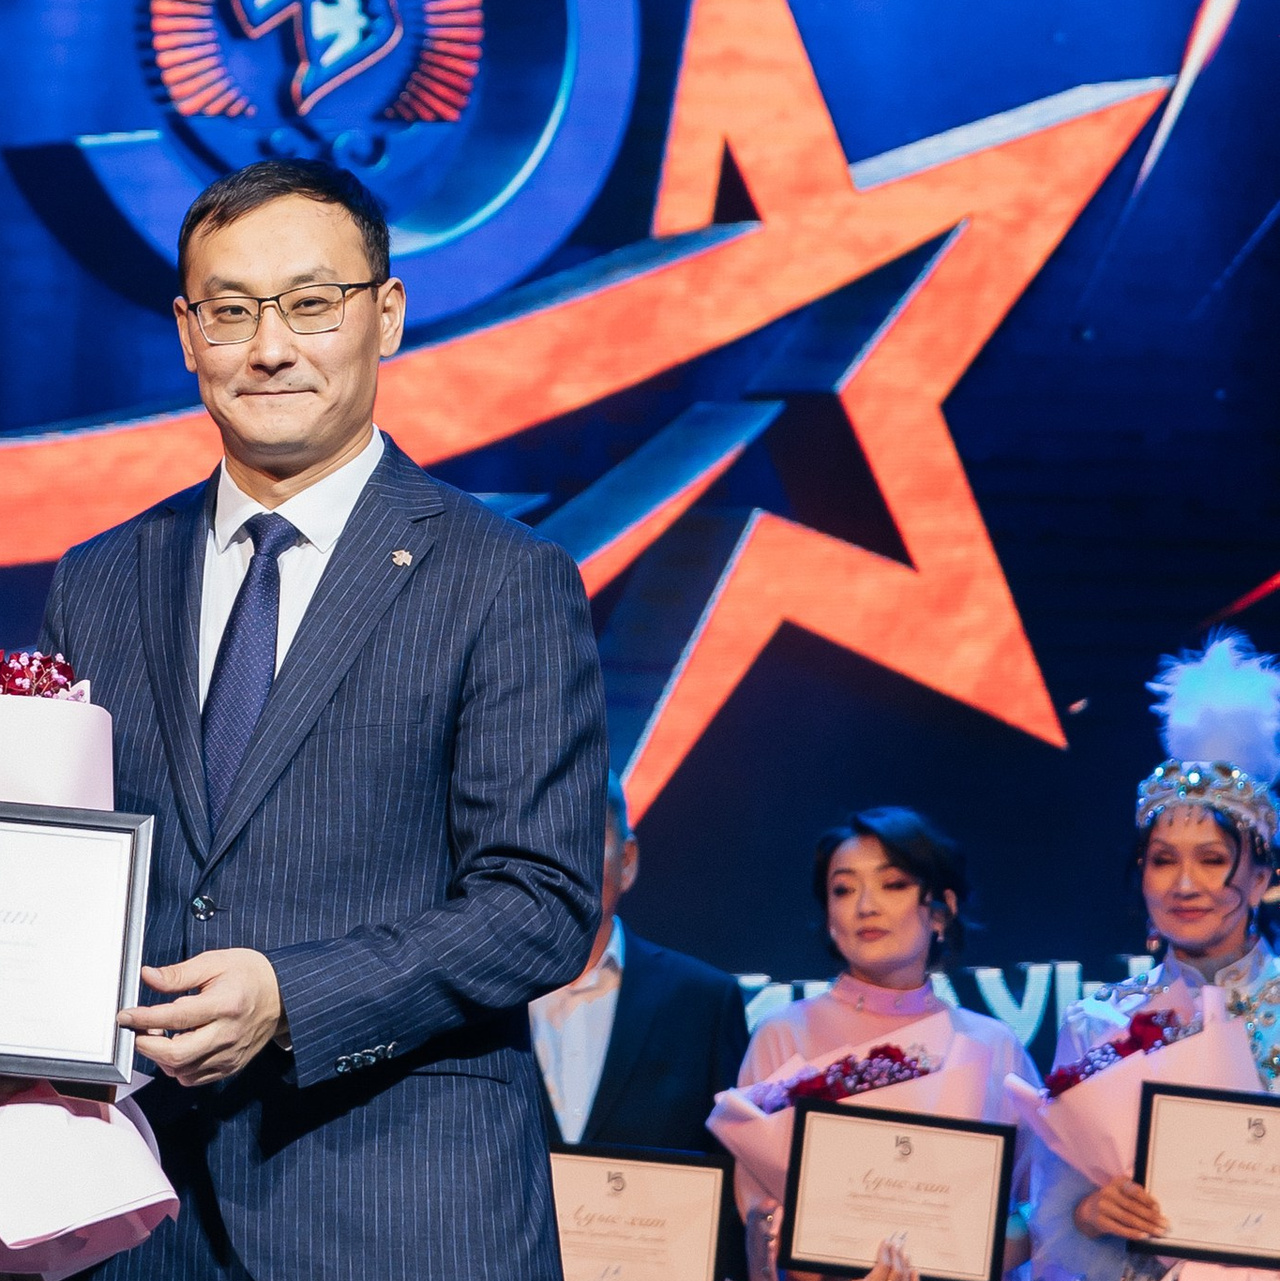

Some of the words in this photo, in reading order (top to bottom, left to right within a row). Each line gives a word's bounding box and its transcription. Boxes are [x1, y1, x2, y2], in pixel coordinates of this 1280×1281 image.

[1247, 1117, 1266, 1138] 15
[895, 1135, 913, 1156] 15
[606, 1171, 626, 1192] 15
